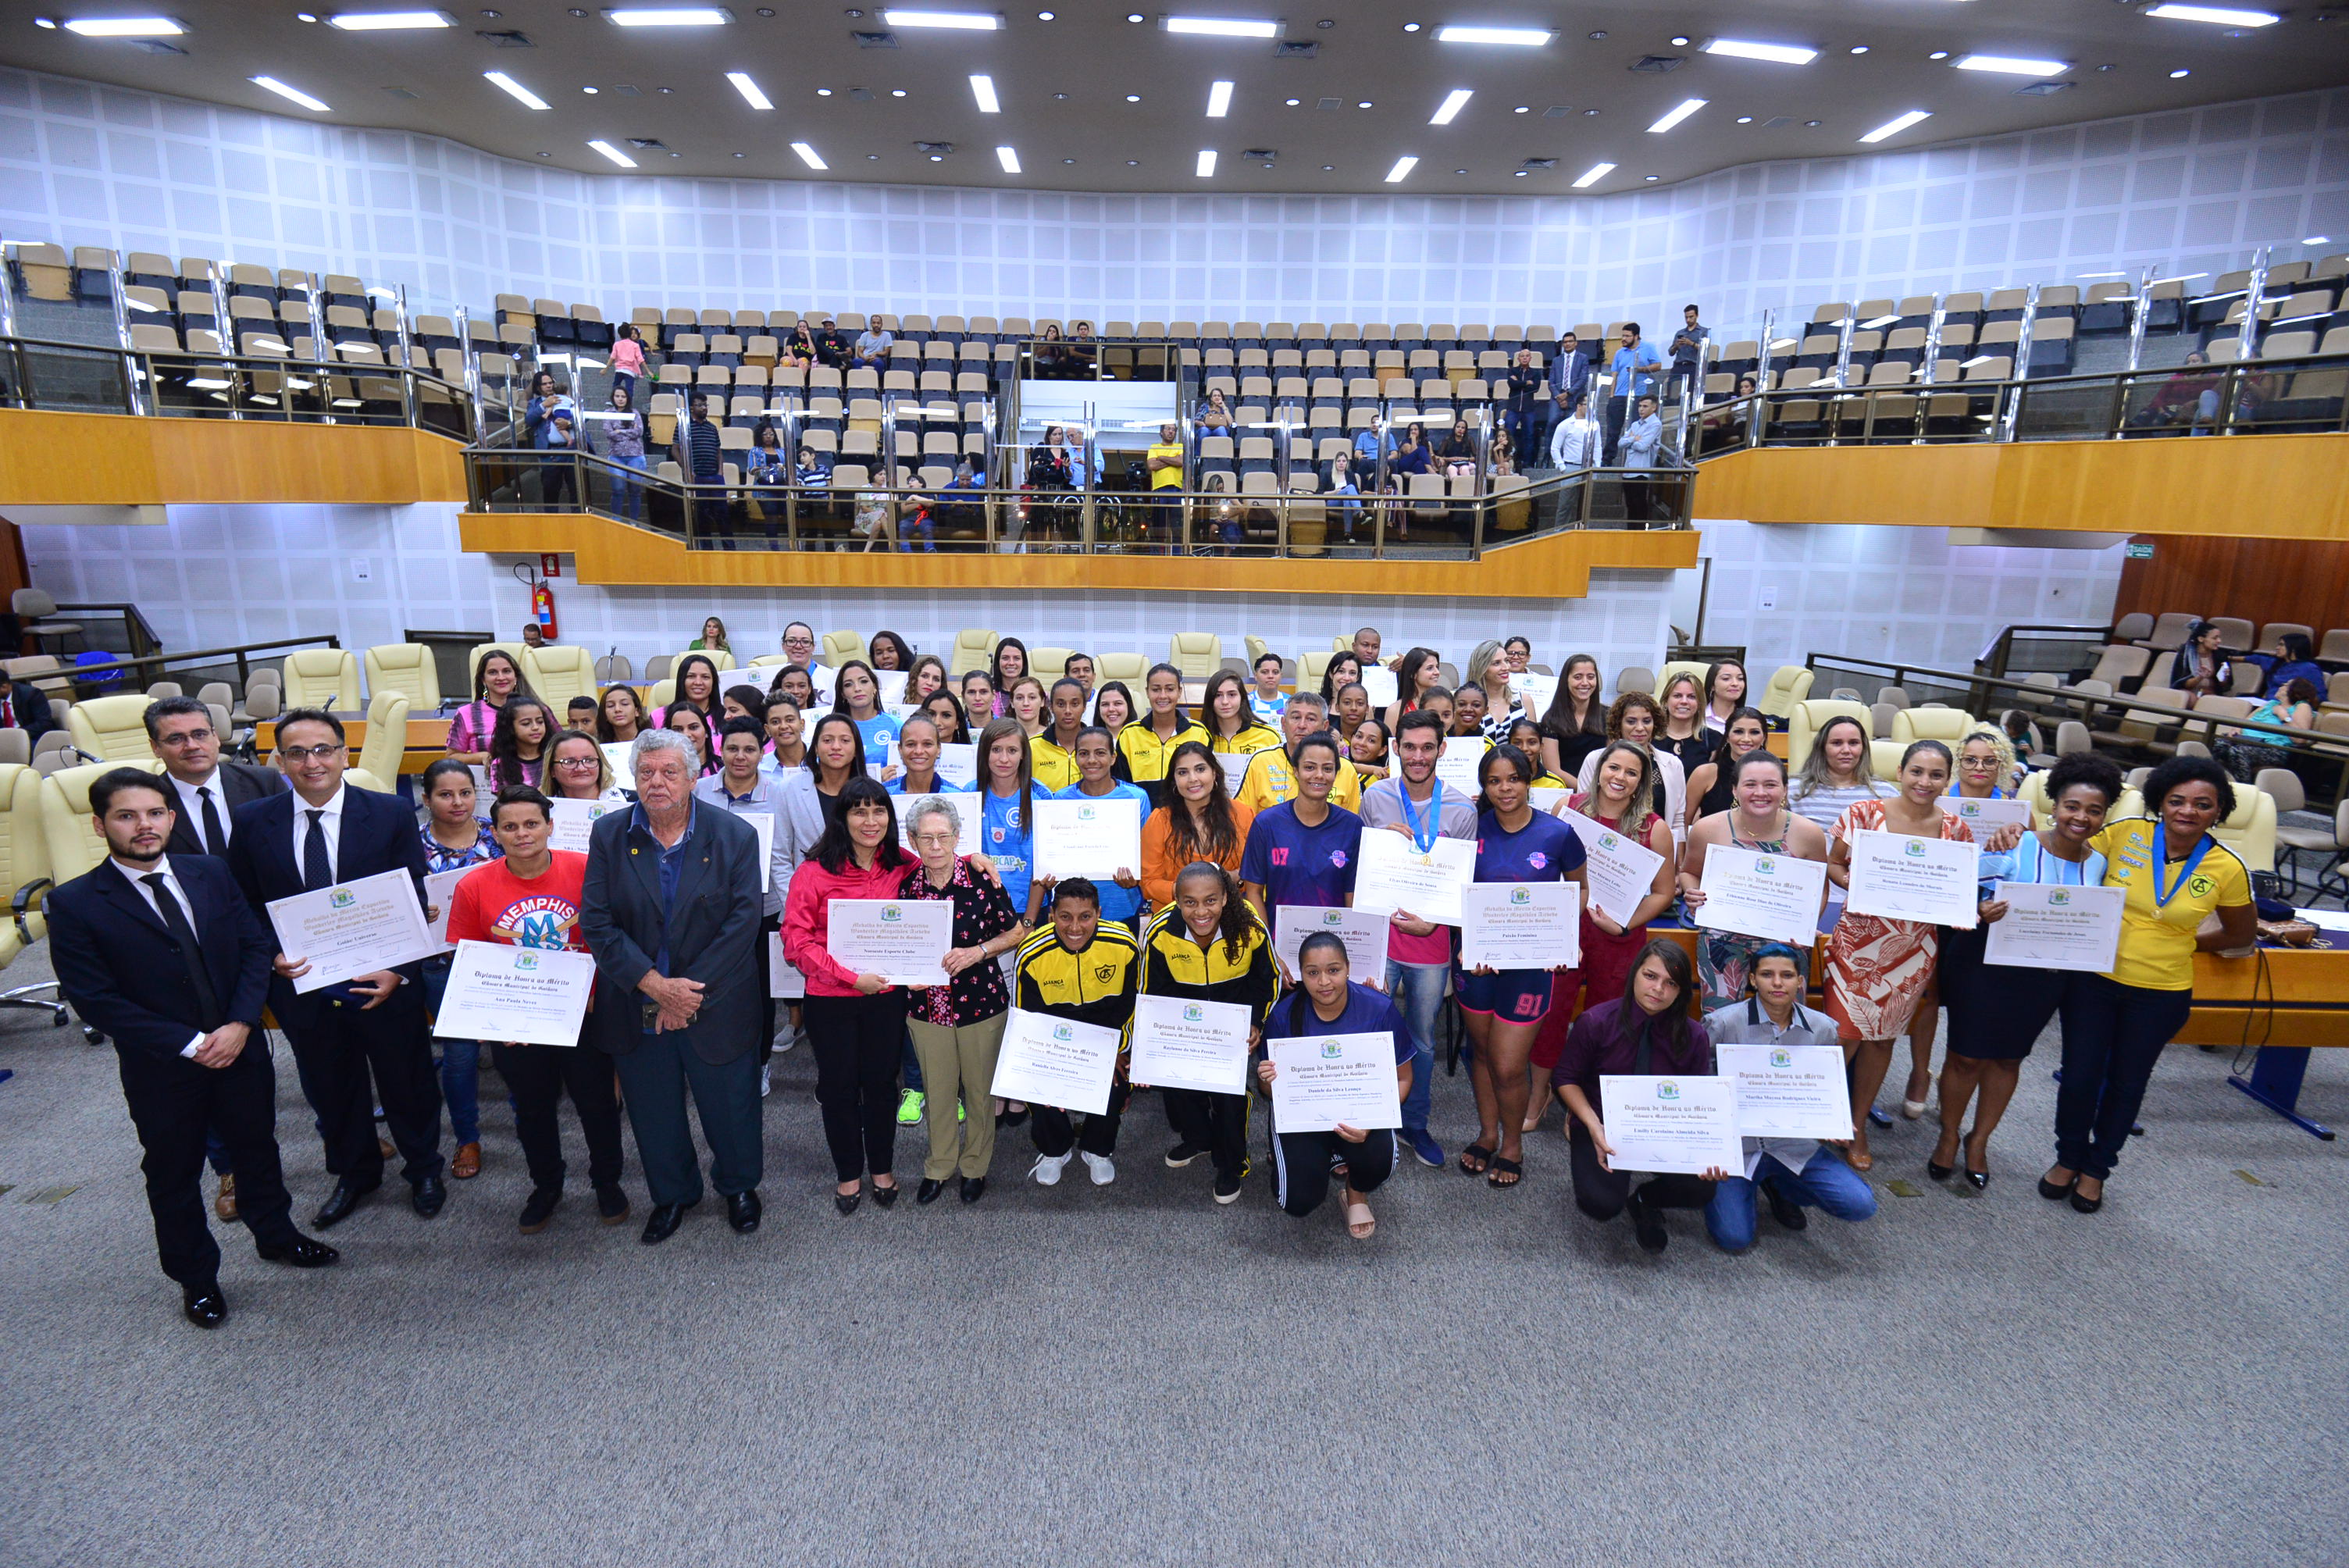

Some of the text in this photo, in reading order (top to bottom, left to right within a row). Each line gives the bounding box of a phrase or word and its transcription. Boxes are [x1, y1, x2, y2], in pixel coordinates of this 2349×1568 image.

[1271, 847, 1289, 866] 07
[497, 898, 575, 930] MEMPHIS
[1514, 993, 1543, 1017] 91
